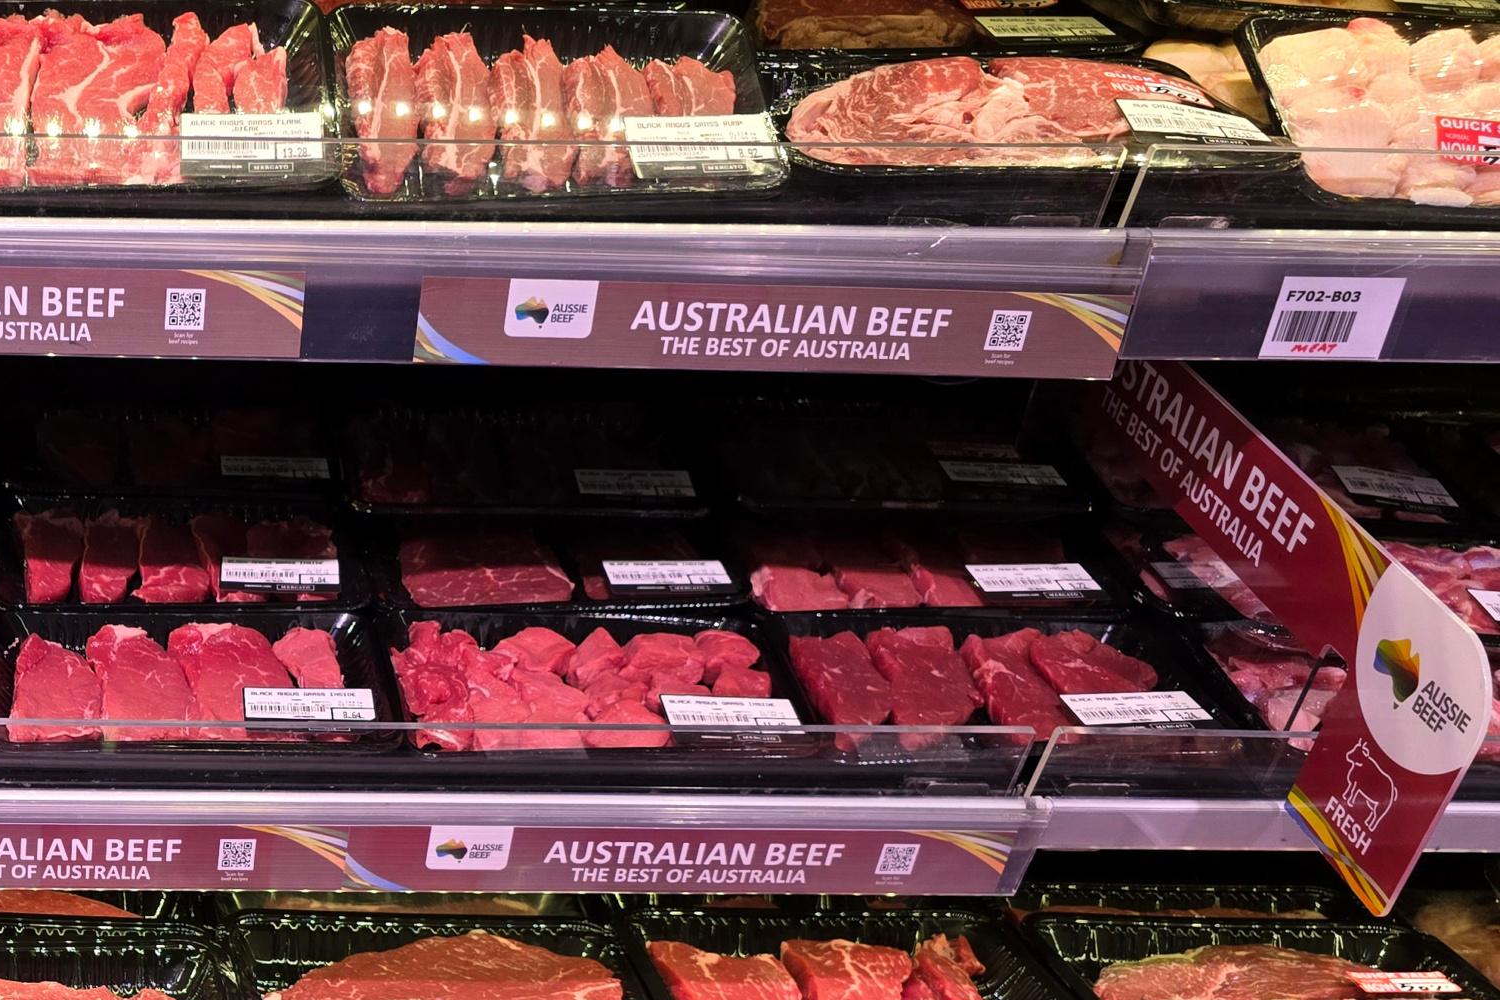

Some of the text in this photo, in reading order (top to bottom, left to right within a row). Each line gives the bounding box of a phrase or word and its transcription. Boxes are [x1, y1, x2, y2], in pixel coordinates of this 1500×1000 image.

[1440, 118, 1492, 132] QUICK
[42, 286, 124, 318] BEEF
[1287, 291, 1361, 302] F702-B03
[551, 312, 575, 323] BEEF
[553, 303, 588, 315] AUSSIE
[630, 301, 952, 337] AUSTRALIAN BEEF
[660, 336, 910, 360] THE BEST OF AUSTRALIA
[1101, 385, 1263, 569] THE BEST OF AUSTRALIA
[1240, 466, 1315, 553] BEEF
[1412, 698, 1448, 735] BEEF
[1421, 680, 1472, 735] AUSSIE
[1325, 796, 1373, 856] FRESH
[105, 838, 182, 862] BEEF
[468, 851, 490, 860] BEEF
[470, 844, 504, 853] AUSSIE
[544, 841, 845, 867] AUSTRALIAN BEEF
[11, 864, 38, 878] OF
[42, 865, 150, 880] AUSTRALIA
[572, 867, 806, 884] THE BEST OF AUSTRALIA
